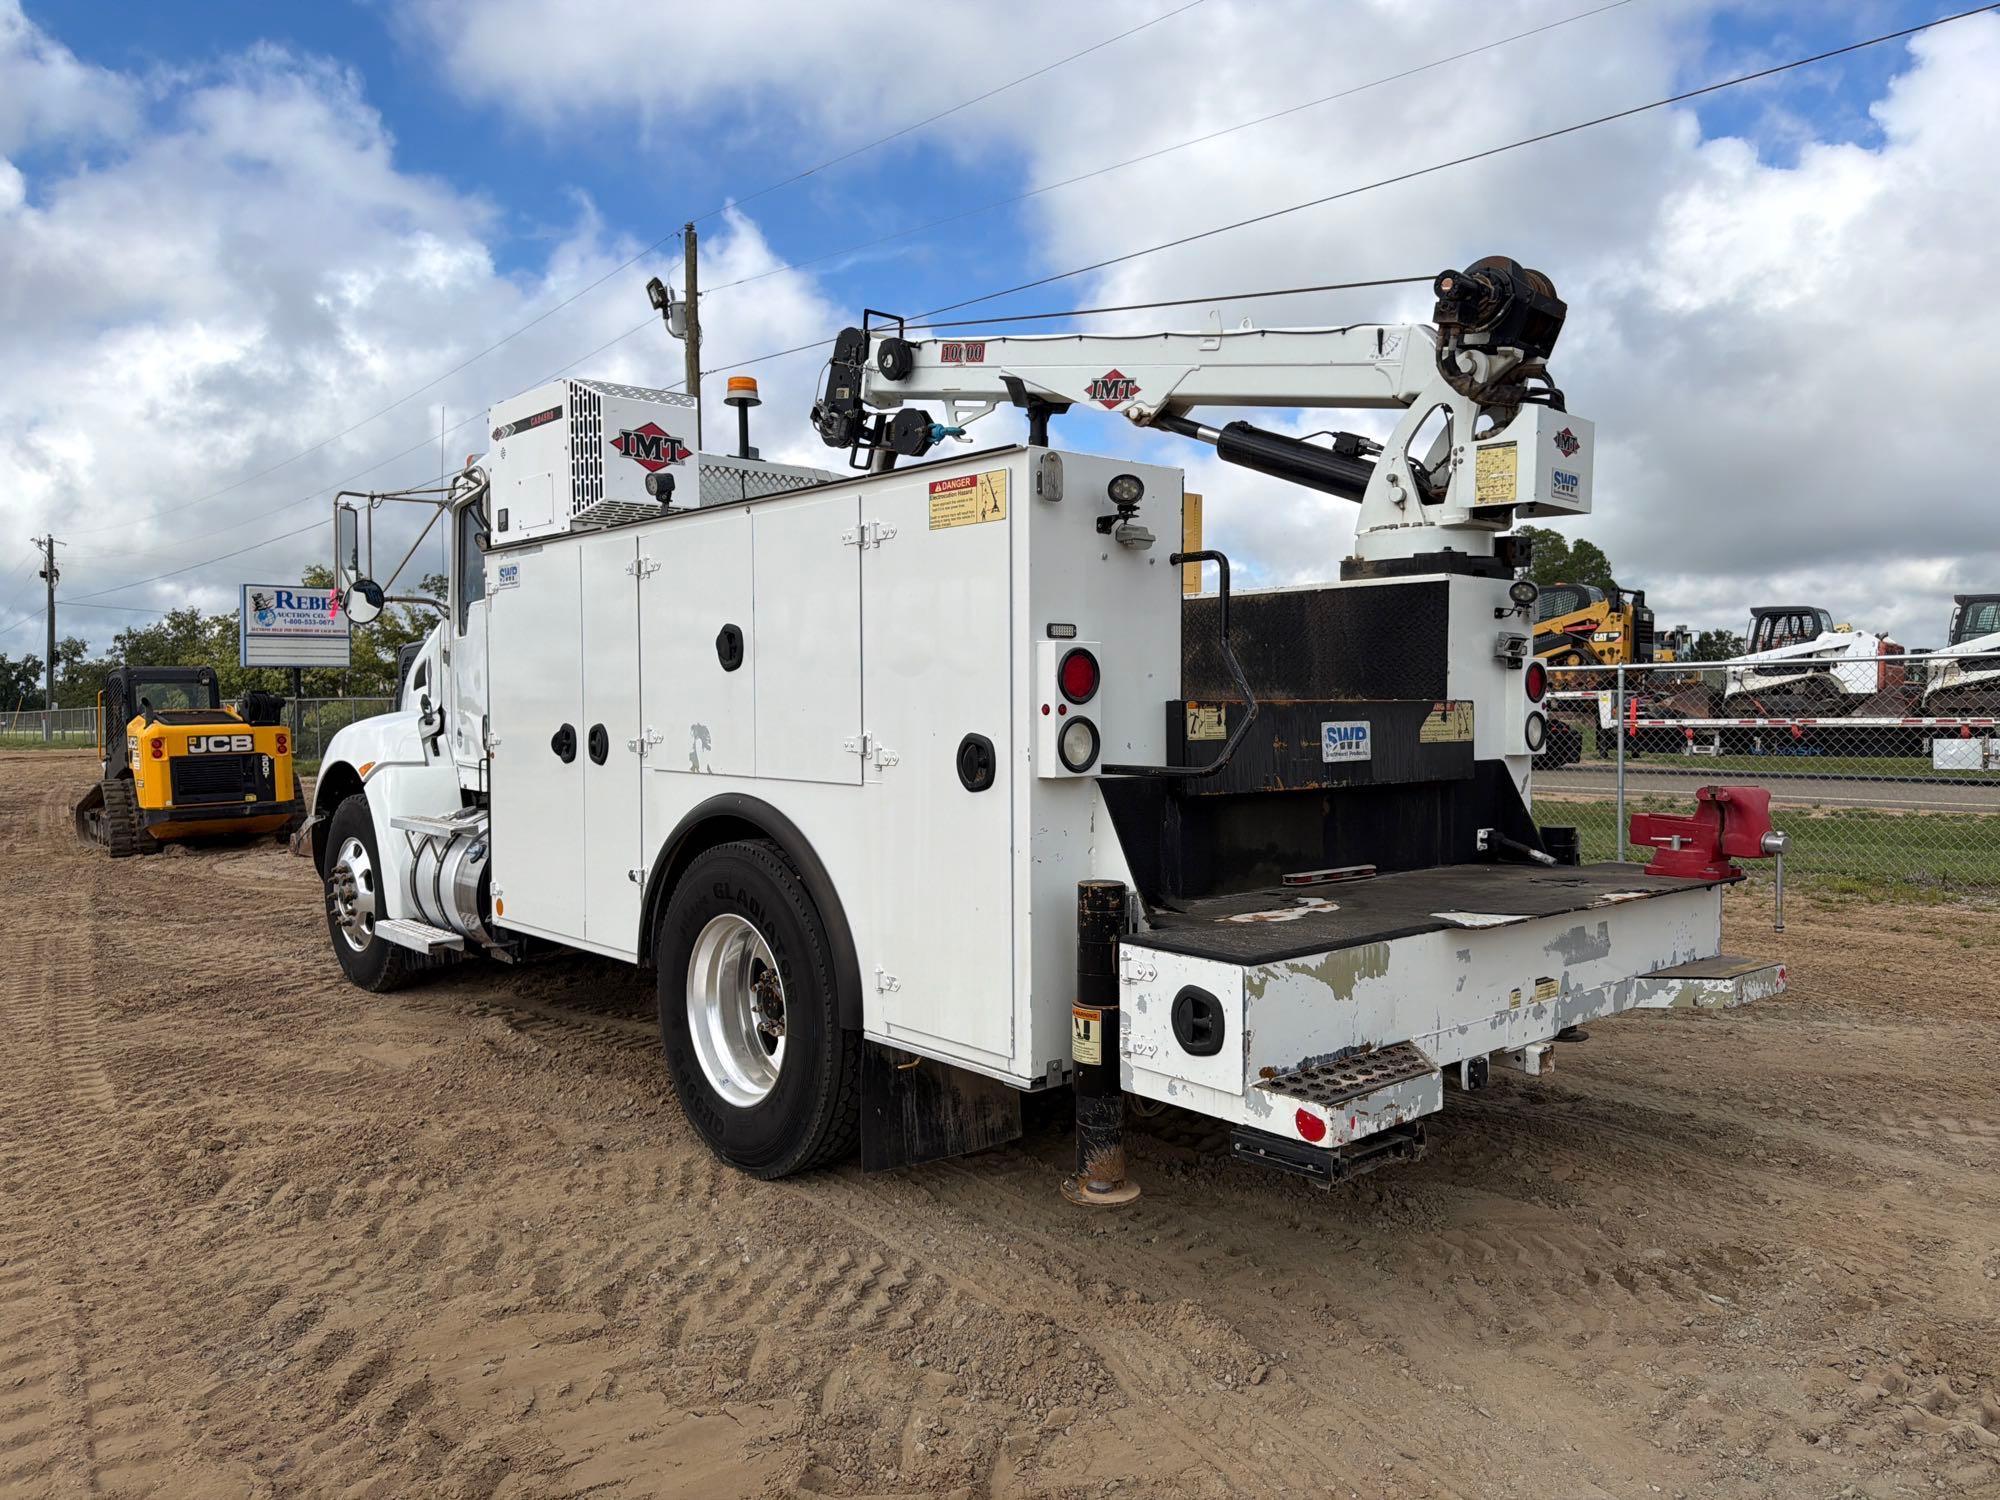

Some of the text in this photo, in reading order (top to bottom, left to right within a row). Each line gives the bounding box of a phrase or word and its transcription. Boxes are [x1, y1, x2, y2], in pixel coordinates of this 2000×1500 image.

[1091, 379, 1134, 399] IMT
[620, 430, 684, 463] IMT
[1556, 431, 1577, 451] IMT
[942, 477, 970, 490] DANGER
[1554, 471, 1577, 487] SWP
[500, 566, 517, 577] SWP
[275, 590, 344, 611] REBE
[1594, 633, 1607, 641] CAT
[189, 735, 252, 753] JCB
[1327, 727, 1366, 744] SWP
[1075, 1010, 1098, 1019] WARNING
